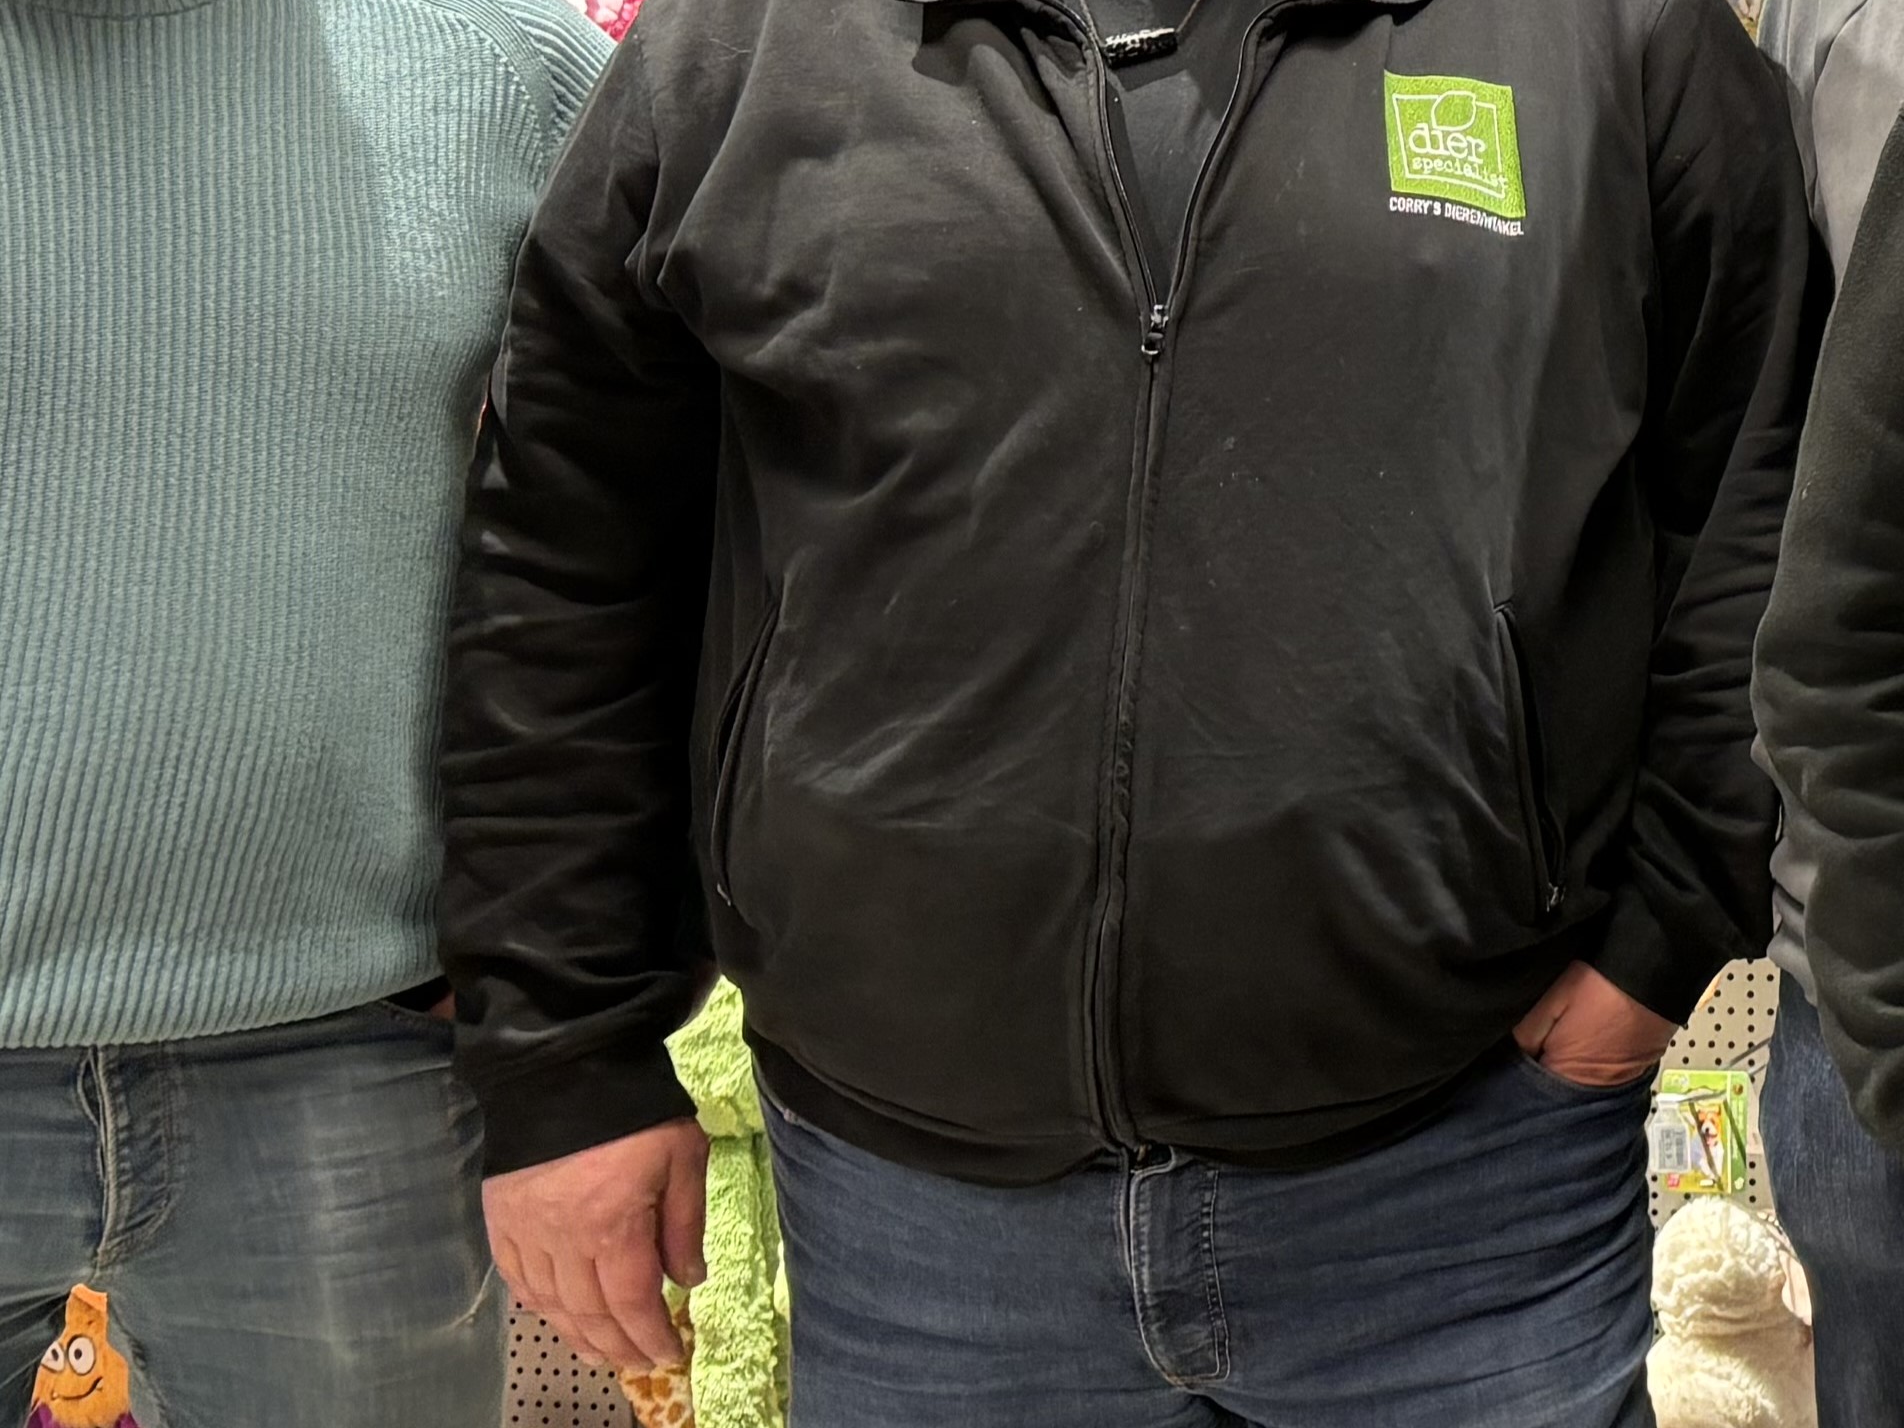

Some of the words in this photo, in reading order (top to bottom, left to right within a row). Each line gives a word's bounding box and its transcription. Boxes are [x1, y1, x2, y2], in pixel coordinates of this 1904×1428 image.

[1408, 122, 1486, 164] dier
[1412, 156, 1508, 189] specialist
[1389, 195, 1442, 216] CORRY'S
